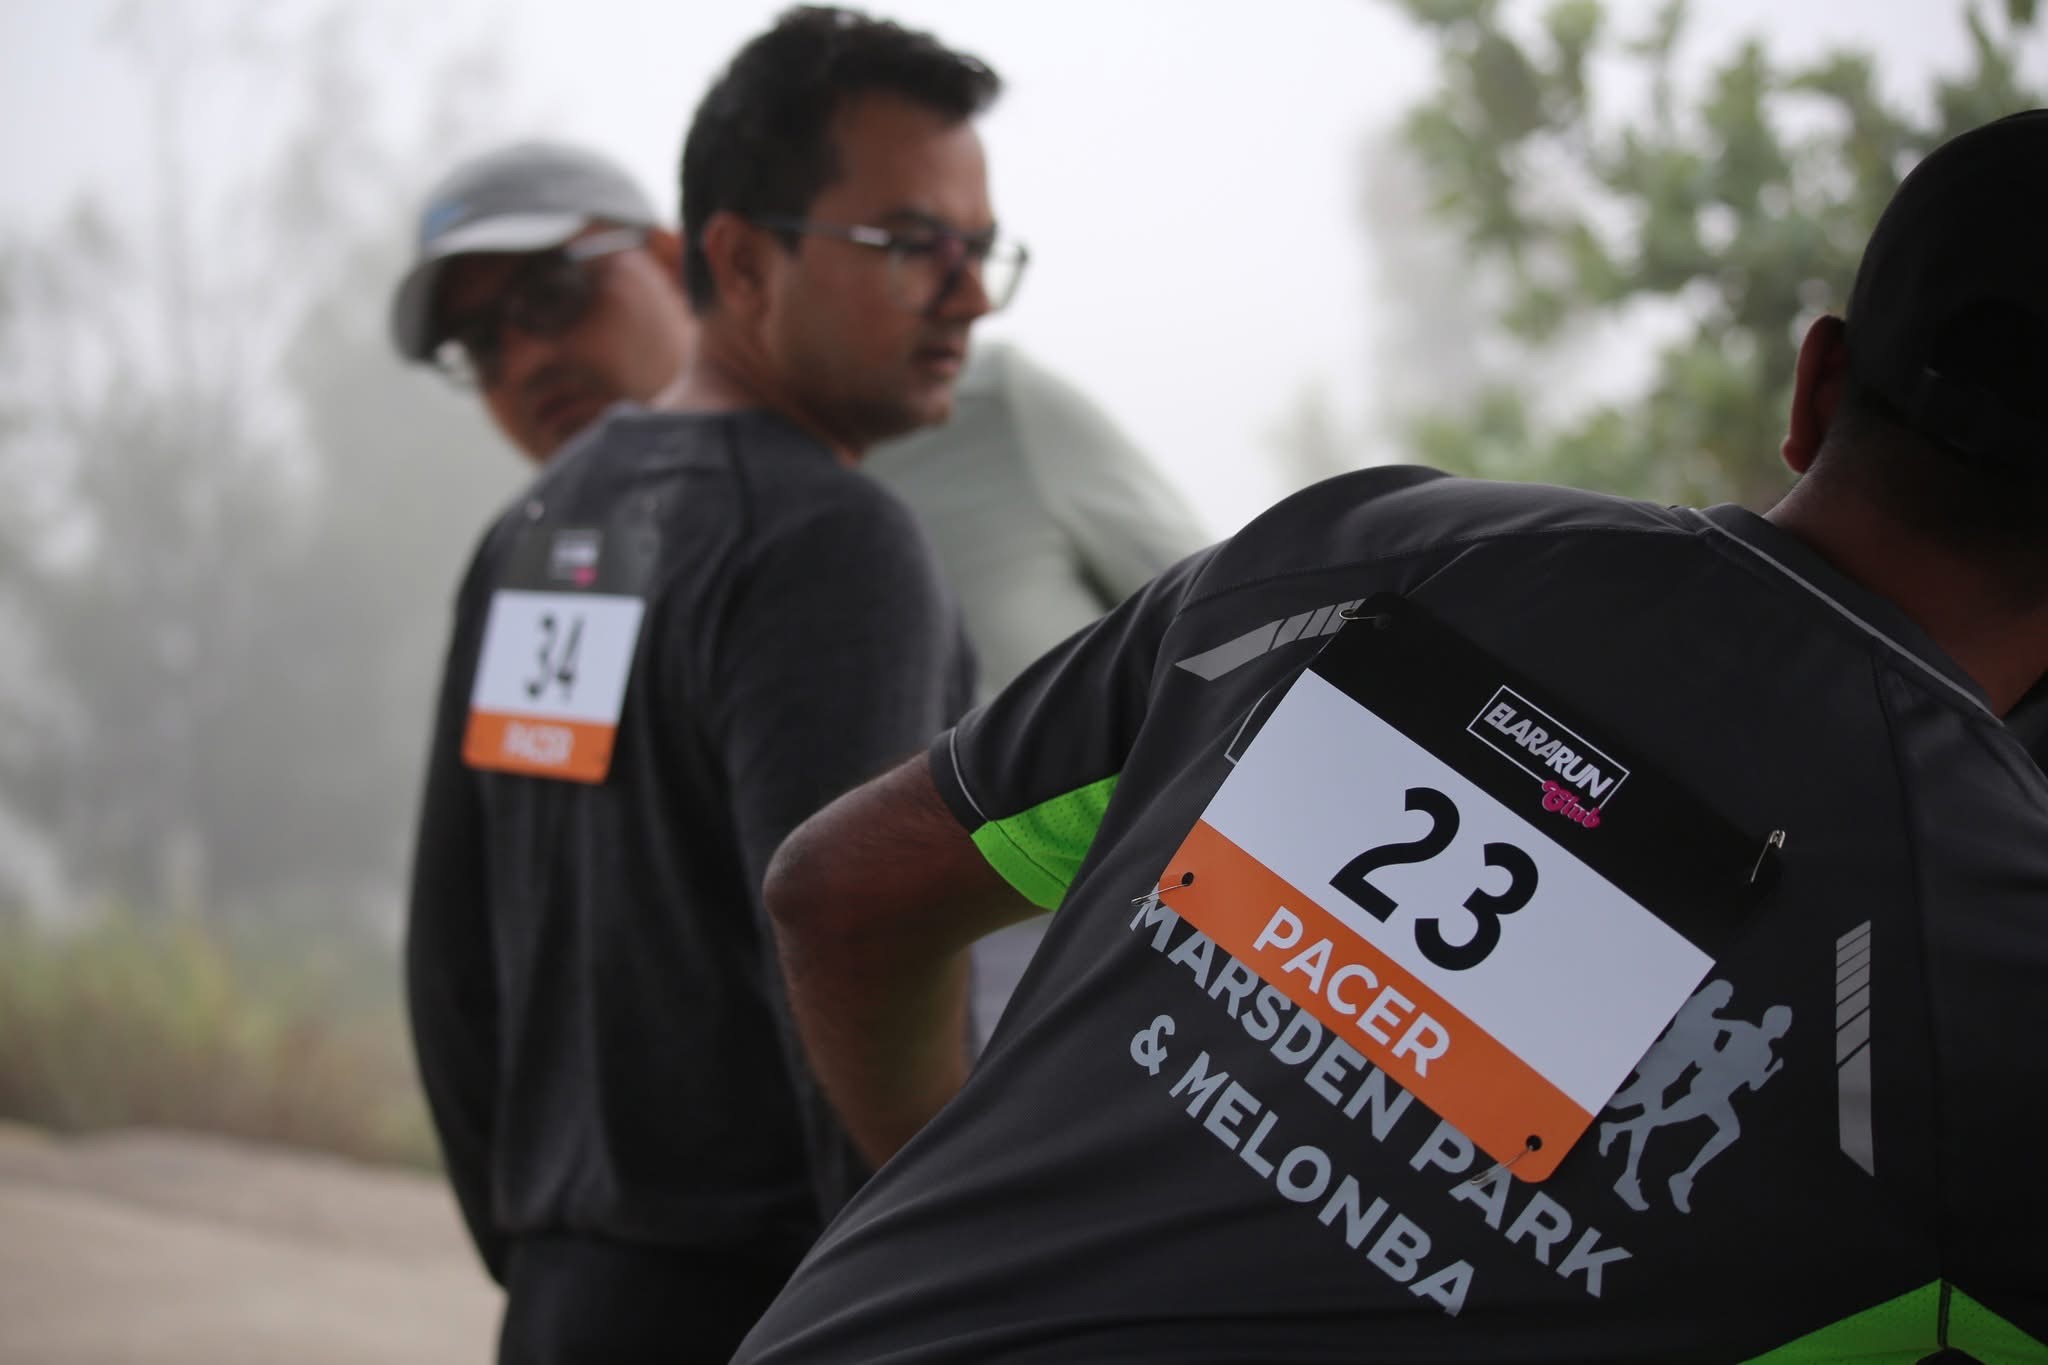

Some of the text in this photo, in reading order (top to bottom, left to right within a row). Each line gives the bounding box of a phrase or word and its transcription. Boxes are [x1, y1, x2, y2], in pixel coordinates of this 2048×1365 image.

[524, 611, 587, 703] 34
[1328, 786, 1540, 971] 23
[1541, 780, 1601, 828] Club
[1253, 906, 1450, 1078] PACER
[1130, 885, 1633, 1298] MARSDEN PARK
[1130, 1014, 1475, 1317] & MELONBA
